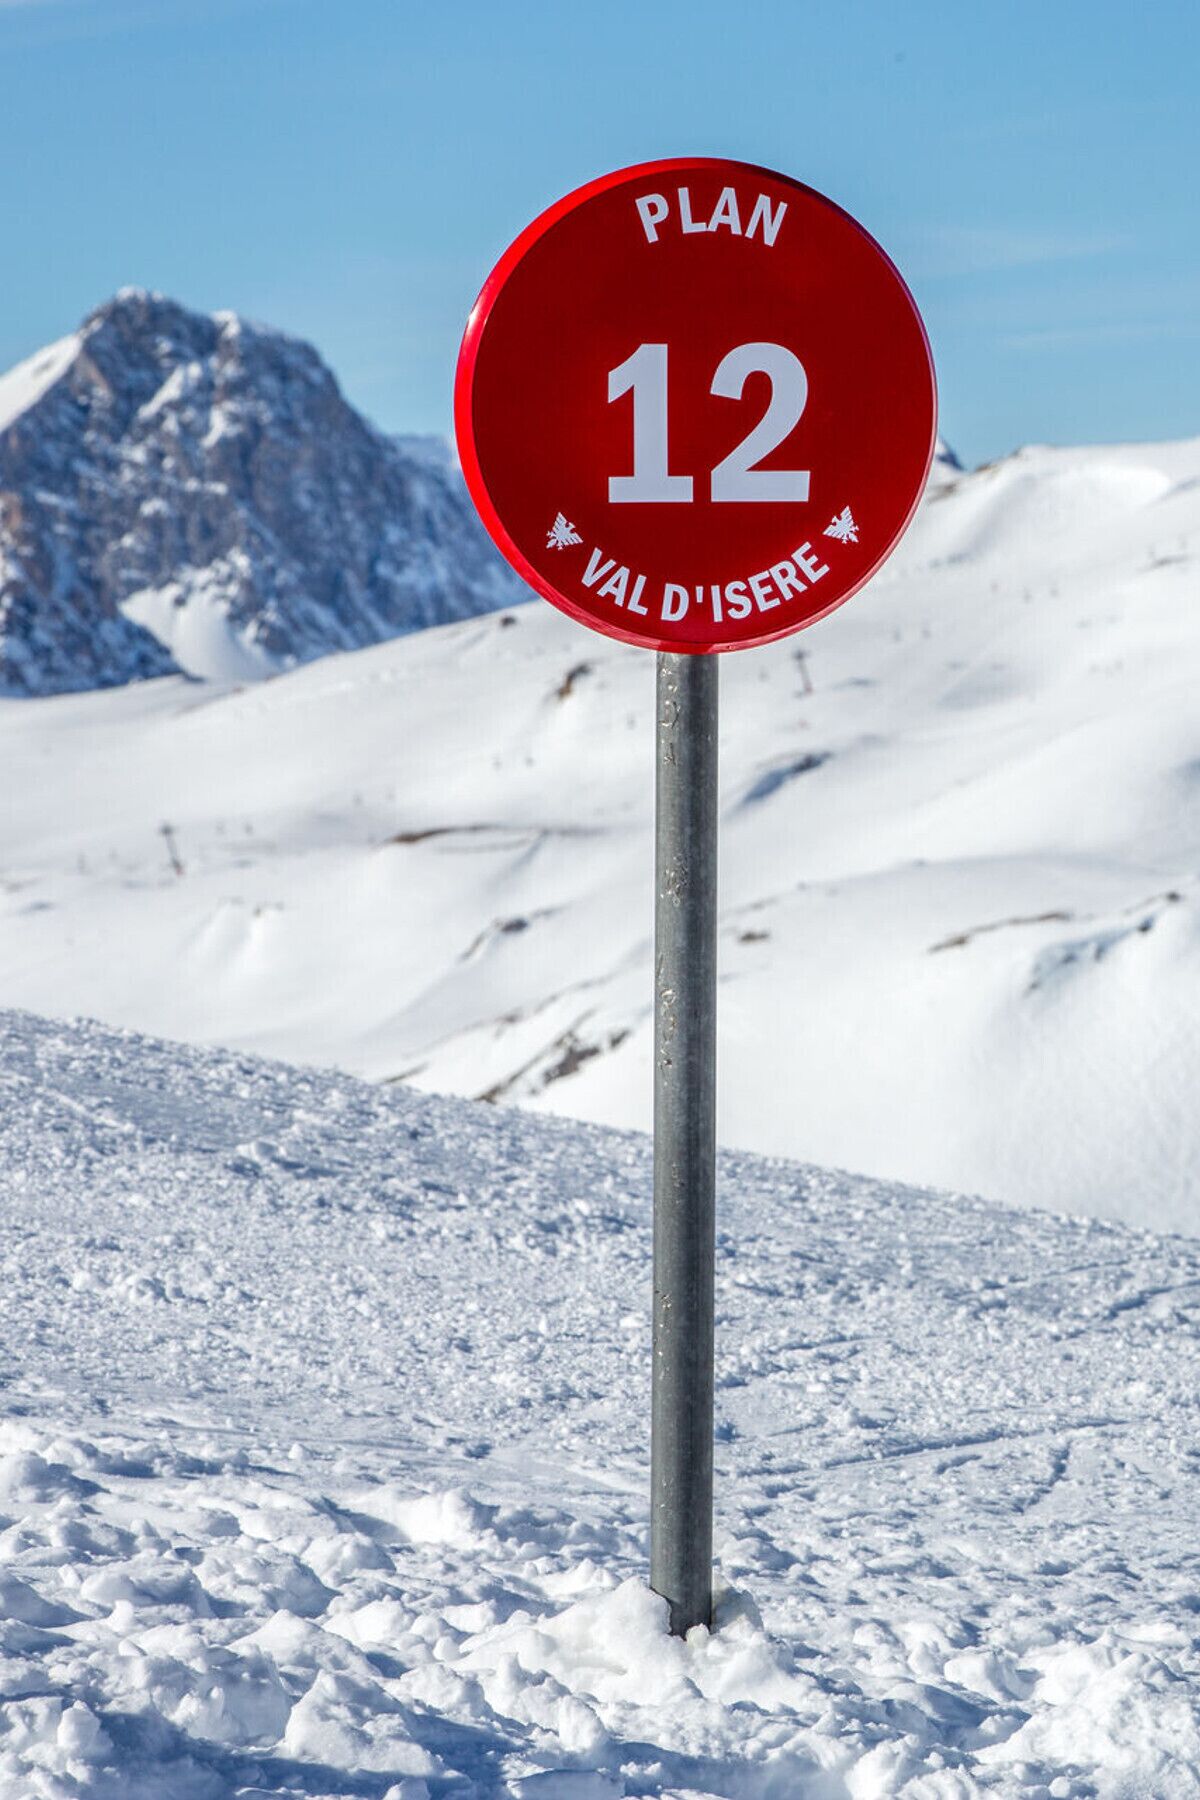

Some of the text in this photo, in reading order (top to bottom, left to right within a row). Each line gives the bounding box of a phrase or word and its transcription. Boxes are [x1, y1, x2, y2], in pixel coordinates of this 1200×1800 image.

[635, 186, 788, 247] PLAN
[607, 342, 811, 503] 12
[581, 541, 830, 623] VAL D'ISERE
